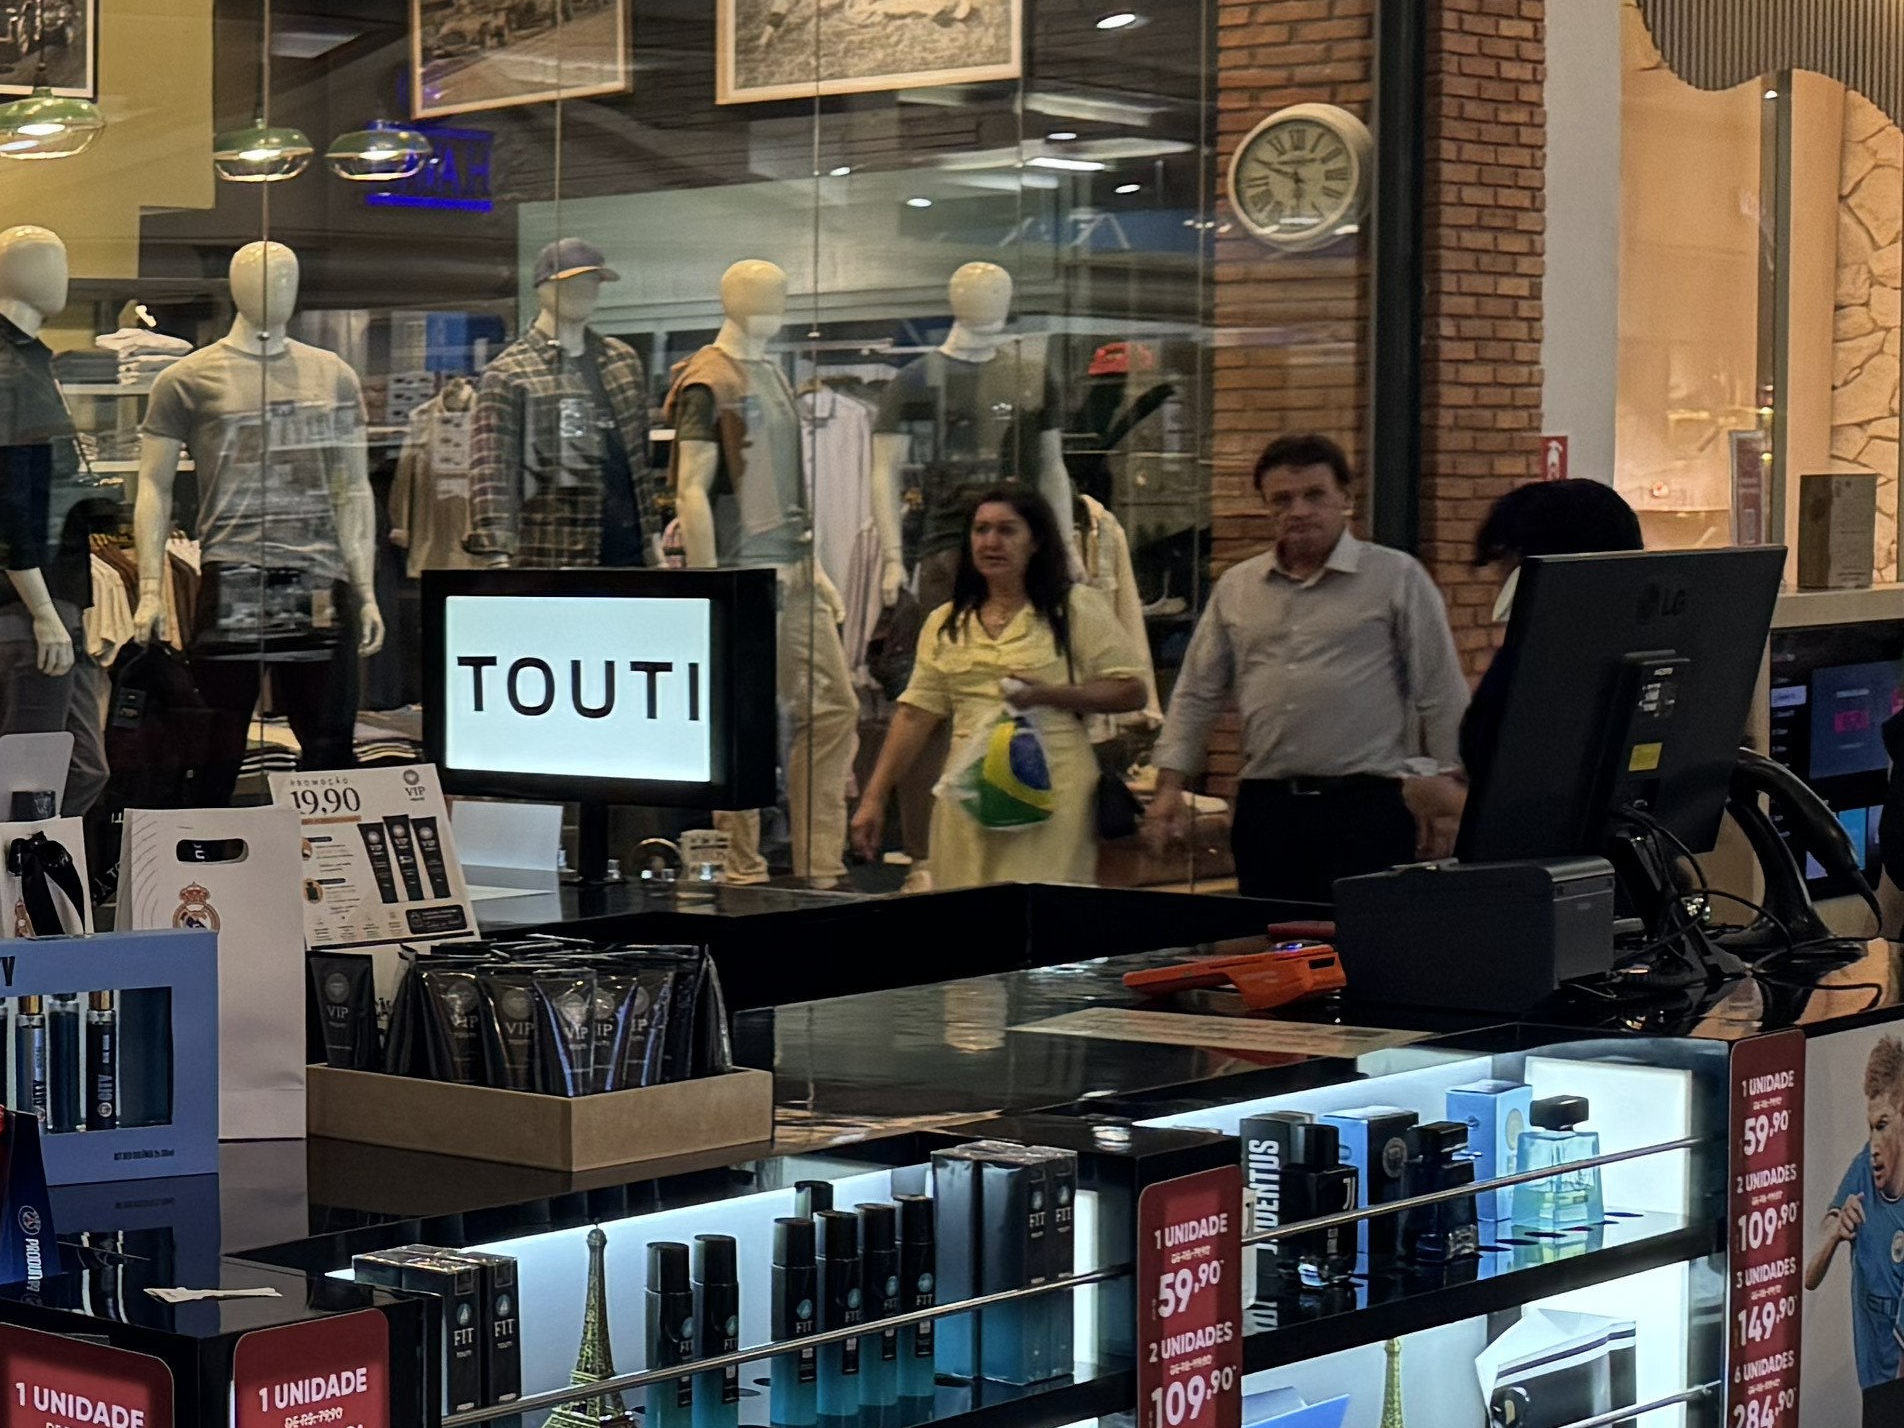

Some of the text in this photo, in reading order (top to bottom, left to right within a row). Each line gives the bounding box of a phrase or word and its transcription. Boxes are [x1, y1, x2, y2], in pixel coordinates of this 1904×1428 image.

[1661, 588, 1686, 616] LG
[457, 654, 700, 721] TOUTI
[405, 786, 425, 797] VIP
[327, 1007, 349, 1019] VIP
[506, 1022, 534, 1035] VIP
[564, 1026, 589, 1040] VIP
[97, 1074, 113, 1102] CITY
[1741, 1070, 1794, 1096] 1 UNIDADE
[1736, 1163, 1797, 1194] 2 UNIDADES
[1154, 1213, 1228, 1250] 1 UNIDADE
[1736, 1256, 1797, 1289] 3 UNIDADES
[454, 1328, 474, 1346] FIT
[494, 1318, 515, 1337] FIT
[1149, 1321, 1233, 1363] 2 UNIDADES
[1734, 1350, 1794, 1384] 6 UNIDADES
[15, 1382, 26, 1407] 1
[258, 1368, 368, 1413] 1 UNIDADE
